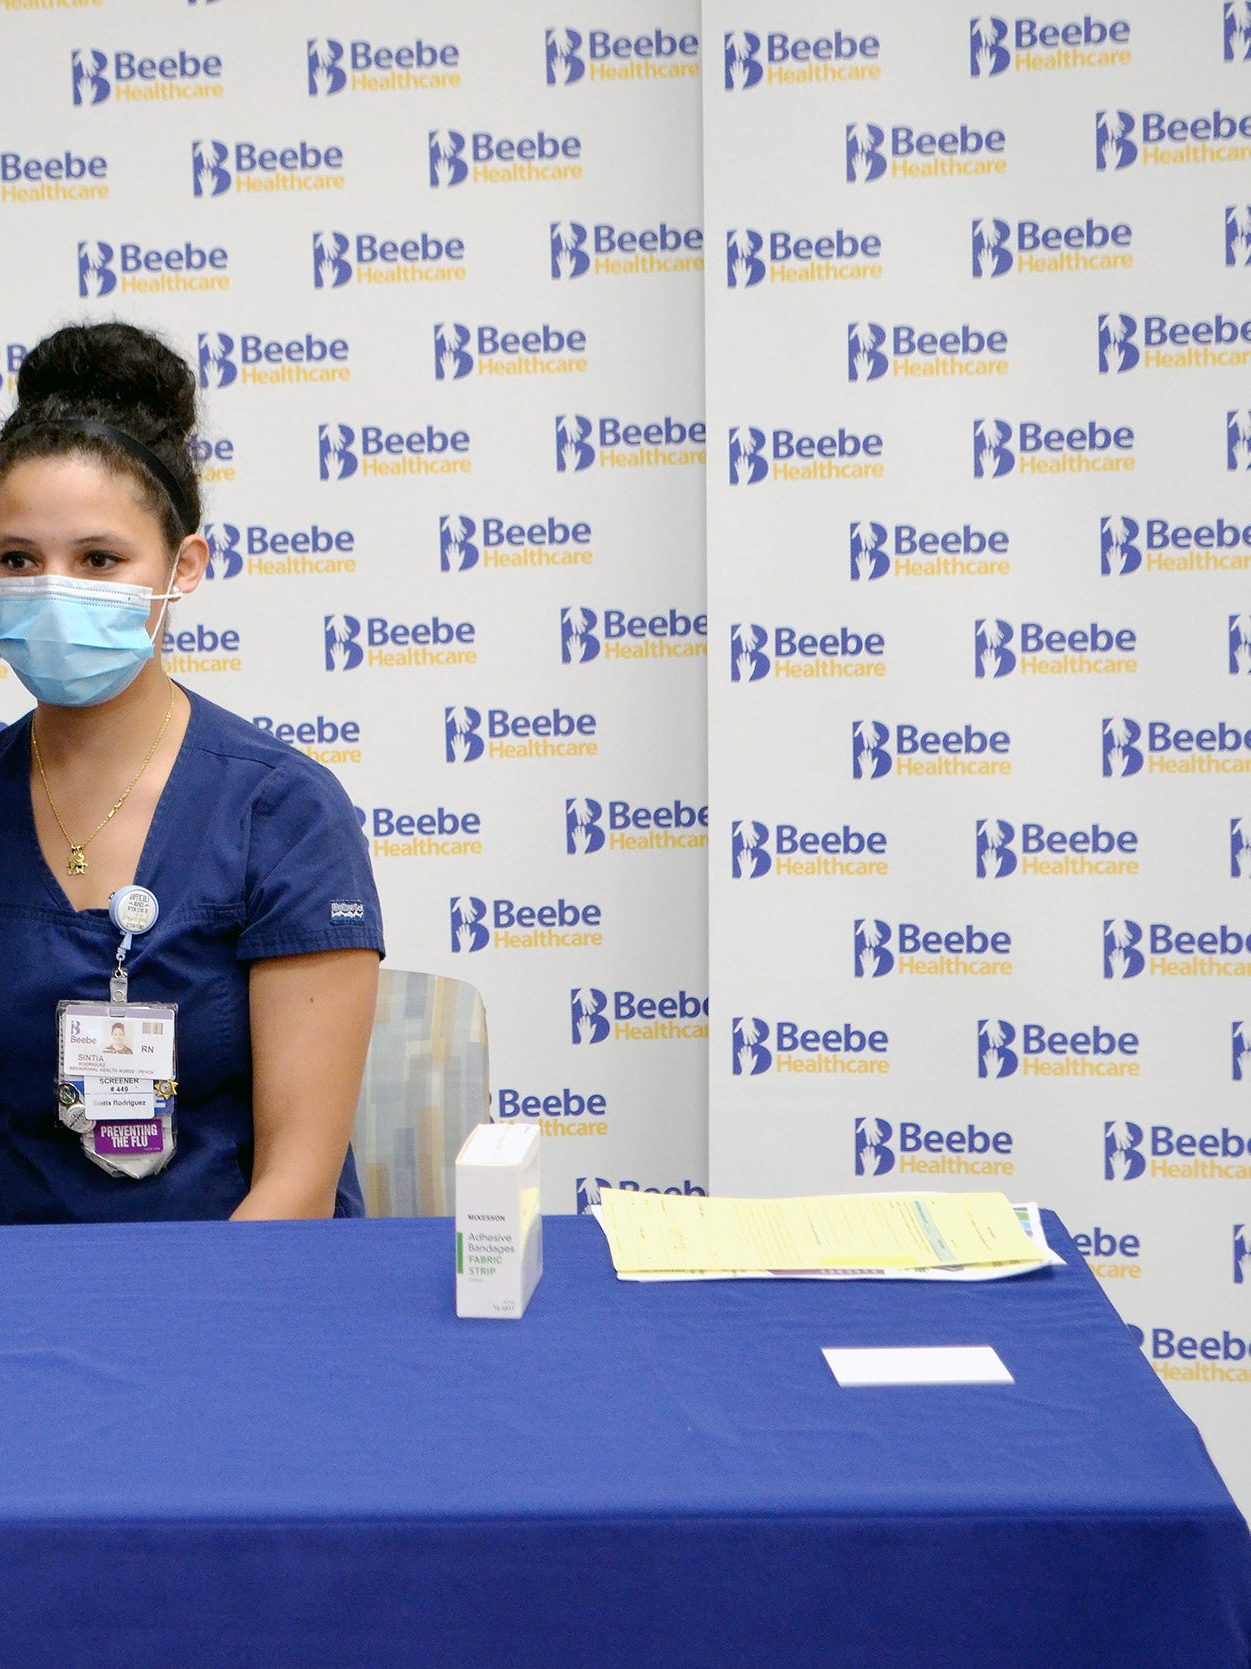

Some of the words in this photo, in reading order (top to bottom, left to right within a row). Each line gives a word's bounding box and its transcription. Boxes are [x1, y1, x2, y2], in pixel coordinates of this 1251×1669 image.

[1015, 16, 1130, 49] Beebe
[589, 29, 699, 59] Beebe
[768, 31, 879, 63] Beebe
[115, 50, 221, 80] Beebe
[351, 40, 459, 70] Beebe
[1015, 48, 1132, 72] Healthcare
[352, 70, 461, 91] Healthcare
[590, 60, 700, 80] Healthcare
[768, 63, 881, 85] Healthcare
[116, 81, 224, 101] Healthcare
[472, 131, 581, 161] Beebe
[892, 125, 1005, 156] Beebe
[1, 152, 107, 181] Beebe
[235, 142, 343, 172] Beebe
[892, 157, 1007, 178] Healthcare
[237, 172, 345, 192] Healthcare
[473, 162, 583, 183] Healthcare
[2, 182, 109, 203] Healthcare
[594, 224, 703, 253] Beebe
[1018, 218, 1132, 251] Beebe
[356, 233, 464, 263] Beebe
[770, 230, 881, 261] Beebe
[121, 243, 228, 272] Beebe
[595, 254, 705, 274] Healthcare
[1018, 251, 1133, 272] Healthcare
[357, 264, 467, 284] Healthcare
[771, 261, 883, 283] Healthcare
[121, 273, 230, 294] Healthcare
[241, 334, 348, 363] Beebe
[478, 325, 586, 354] Beebe
[893, 325, 1007, 355] Beebe
[242, 364, 351, 384] Healthcare
[478, 355, 588, 376] Healthcare
[893, 356, 1009, 377] Healthcare
[362, 425, 469, 455] Beebe
[599, 416, 706, 446] Beebe
[1020, 421, 1134, 452] Beebe
[773, 428, 883, 459] Beebe
[363, 456, 472, 476] Healthcare
[773, 460, 885, 480] Healthcare
[1020, 453, 1136, 474] Healthcare
[247, 525, 354, 555] Beebe
[483, 517, 591, 546] Beebe
[895, 525, 1009, 555] Beebe
[248, 555, 357, 576] Healthcare
[483, 548, 593, 568] Healthcare
[895, 557, 1011, 576] Healthcare
[368, 617, 475, 646] Beebe
[775, 627, 885, 657] Beebe
[1021, 623, 1136, 653] Beebe
[368, 647, 477, 667] Healthcare
[1021, 655, 1138, 675] Healthcare
[775, 659, 886, 678] Healthcare
[488, 708, 596, 738] Beebe
[489, 738, 598, 759] Healthcare
[897, 725, 1010, 754] Beebe
[897, 756, 1012, 776] Healthcare
[373, 807, 480, 837] Beebe
[374, 837, 483, 857] Healthcare
[776, 825, 887, 854] Beebe
[1022, 824, 1138, 854] Beebe
[776, 856, 889, 876] Healthcare
[1022, 856, 1139, 875] Healthcare
[493, 899, 601, 928] Beebe
[494, 929, 603, 948] Healthcare
[899, 924, 1011, 954] Beebe
[899, 956, 1012, 976] Healthcare
[70, 1035, 97, 1045] Beebe
[777, 1022, 888, 1052] Beebe
[1023, 1024, 1139, 1055] Beebe
[78, 1054, 104, 1063] SINTIA
[141, 1045, 154, 1054] RN
[777, 1054, 890, 1074] Healthcare
[1023, 1057, 1141, 1077] Healthcare
[113, 1099, 146, 1108] Rodriguez
[498, 1088, 607, 1118] Beebe
[100, 1124, 158, 1138] PREVENTING
[900, 1122, 1013, 1154] Beebe
[111, 1136, 129, 1149] THE
[131, 1135, 149, 1148] FLU
[899, 1155, 1015, 1175] Healthcare
[469, 1232, 512, 1242] Adhesive
[469, 1243, 516, 1255] Bandages
[469, 1255, 502, 1265] FABRIC
[469, 1267, 497, 1276] STRIP
